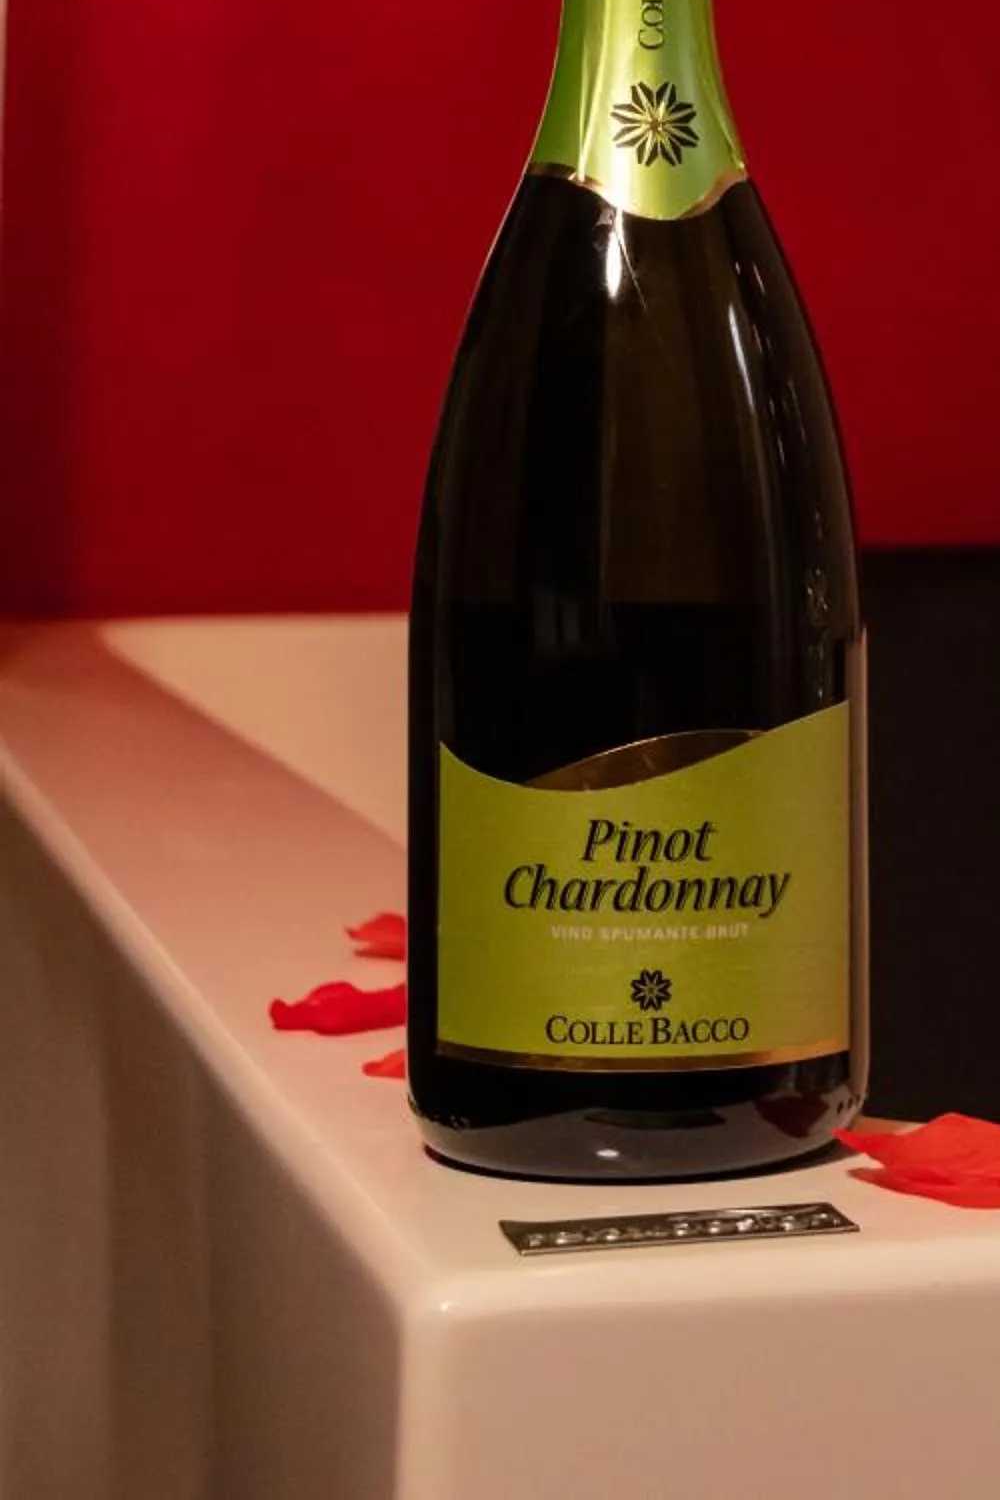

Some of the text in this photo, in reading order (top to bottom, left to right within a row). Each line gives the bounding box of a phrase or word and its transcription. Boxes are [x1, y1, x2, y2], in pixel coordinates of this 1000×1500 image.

[580, 818, 718, 863] Pinot
[503, 863, 792, 918] Chardonnay
[551, 923, 750, 941] VINO SPUMANTE BRUT
[545, 1015, 750, 1046] COLLE BACCO
